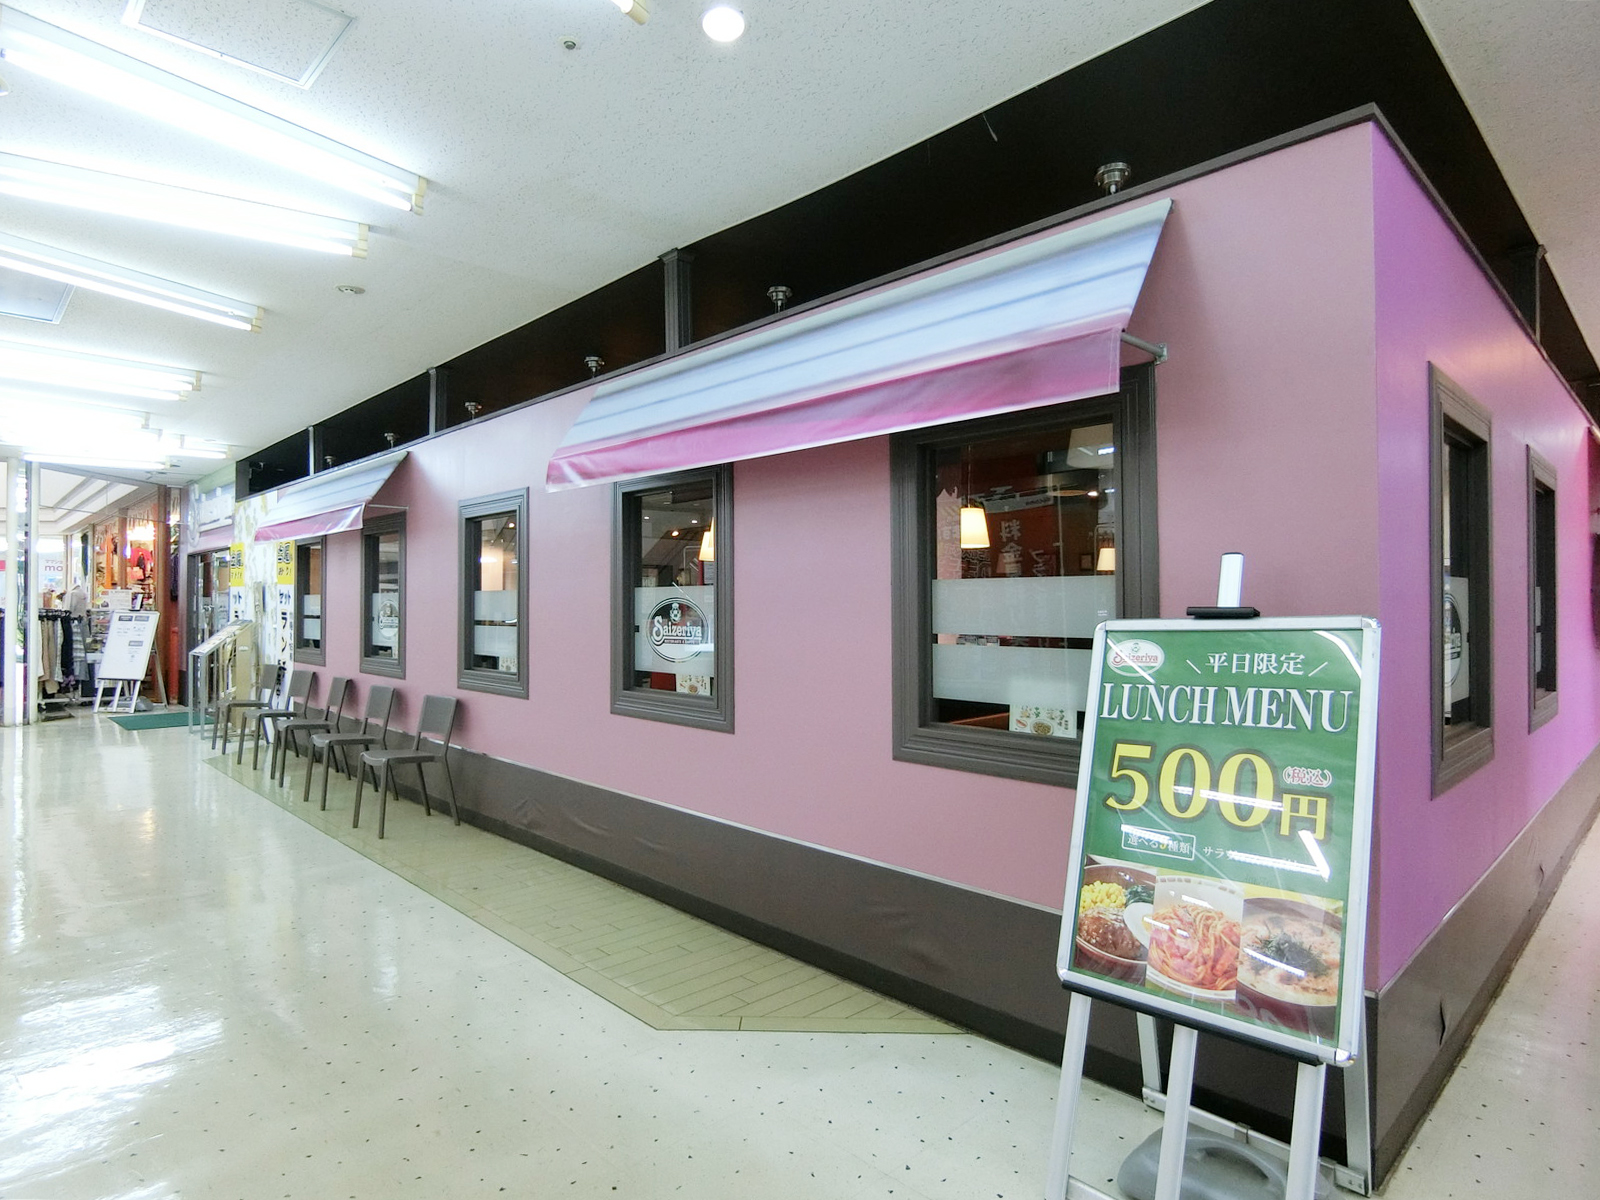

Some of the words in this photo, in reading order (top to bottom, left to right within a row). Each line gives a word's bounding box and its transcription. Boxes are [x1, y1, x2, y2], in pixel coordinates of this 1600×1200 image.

[652, 615, 702, 641] Saizeriya
[1112, 650, 1158, 664] Sizeriya
[1205, 652, 1306, 676] 平日限定
[1100, 682, 1218, 725] LUNCH
[1221, 686, 1353, 733] MENU
